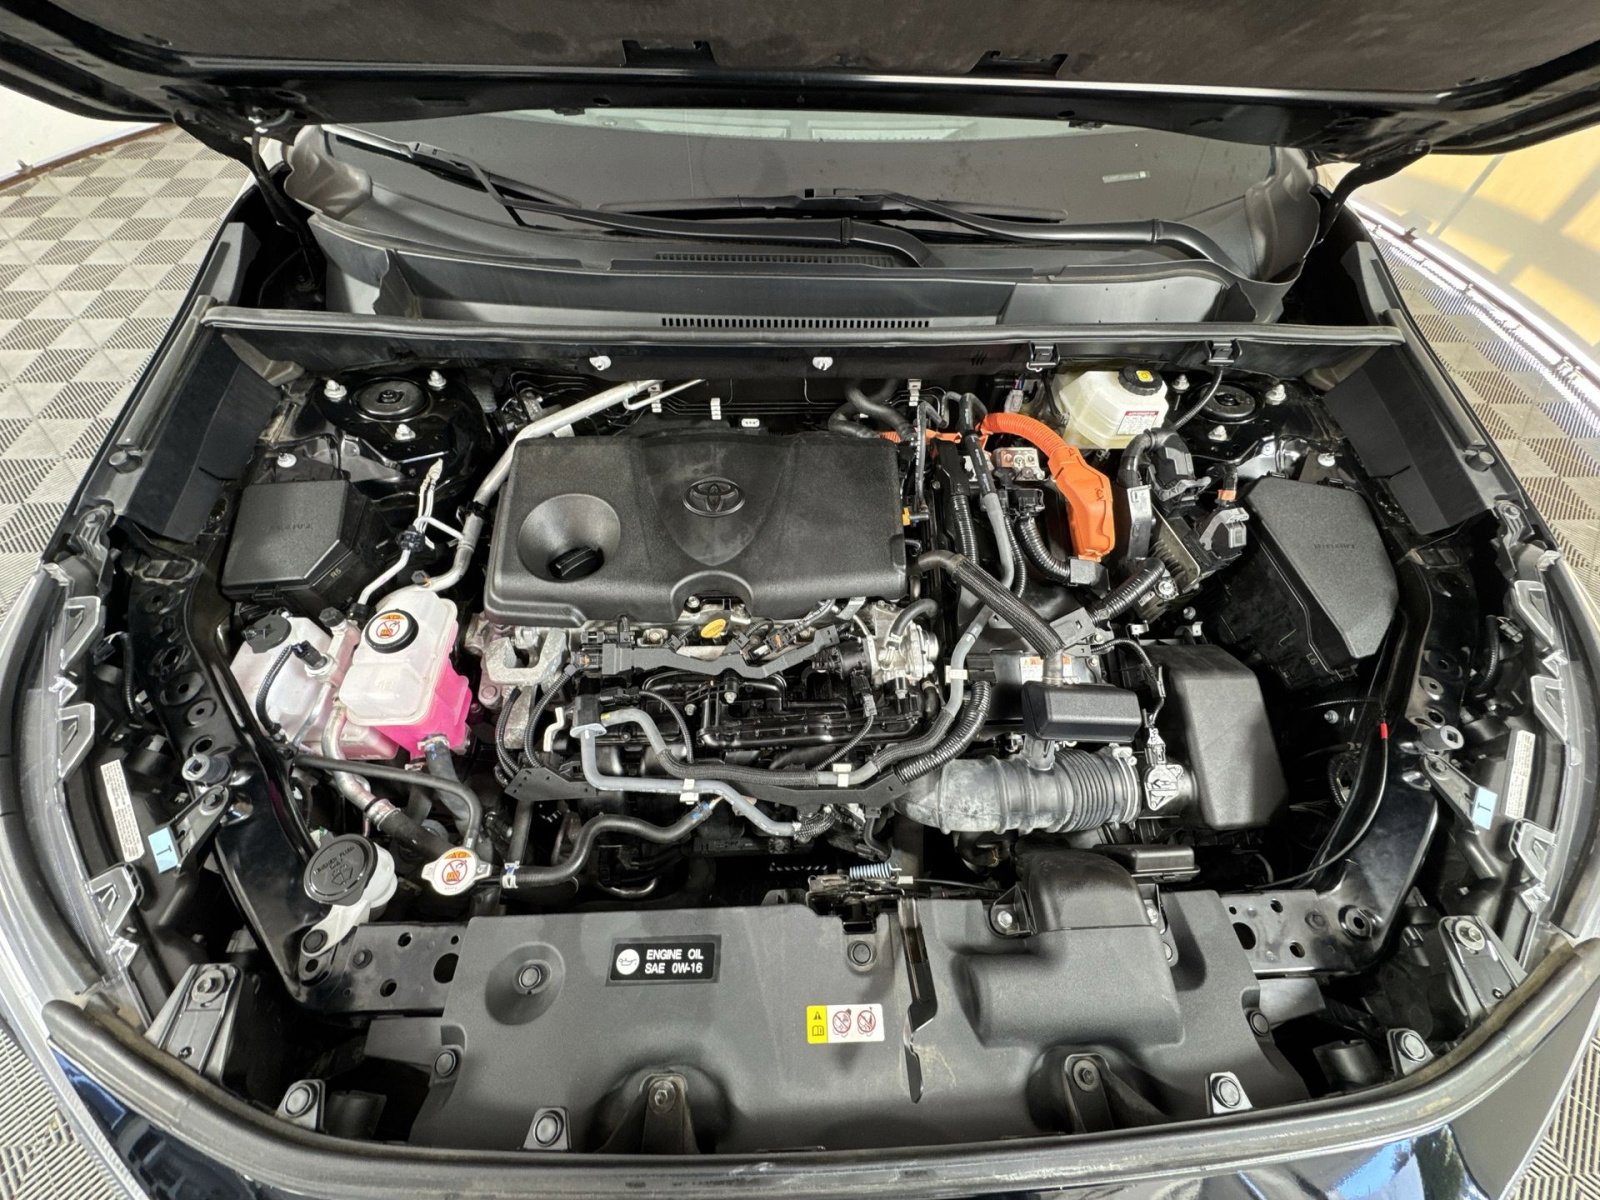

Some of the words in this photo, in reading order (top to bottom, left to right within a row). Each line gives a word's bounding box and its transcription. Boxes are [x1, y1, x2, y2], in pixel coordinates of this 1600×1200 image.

[646, 948, 683, 960] ENGINE
[687, 948, 704, 960] OIL
[644, 962, 666, 975] SAE
[671, 962, 703, 974] 0W-16
